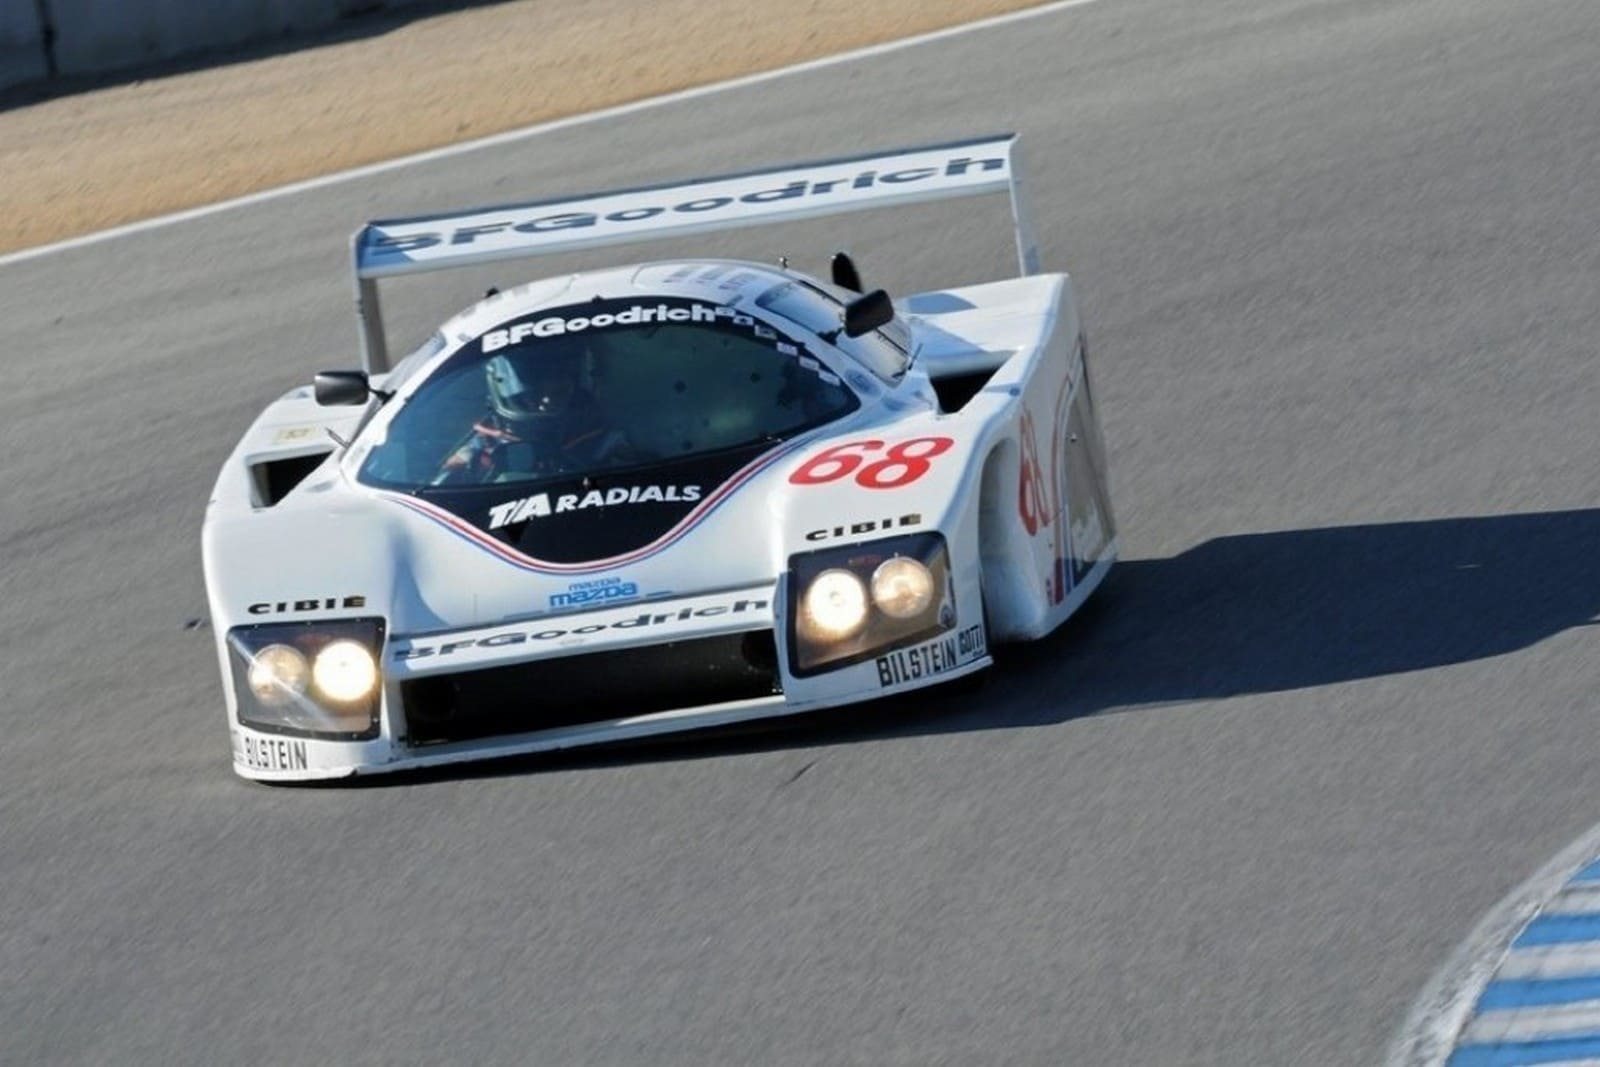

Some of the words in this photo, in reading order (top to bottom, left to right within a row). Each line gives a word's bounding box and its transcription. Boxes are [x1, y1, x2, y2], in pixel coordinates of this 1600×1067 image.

[372, 155, 1006, 256] BFGoodrich
[481, 303, 717, 353] BFGoodrich
[789, 437, 954, 490] 68
[555, 485, 701, 513] RADIALS
[806, 513, 921, 541] CIBIE
[248, 596, 366, 616] CIBIE
[549, 581, 638, 608] mazda
[877, 638, 957, 688] BILSTEIN
[245, 737, 308, 771] BILSTEIN
